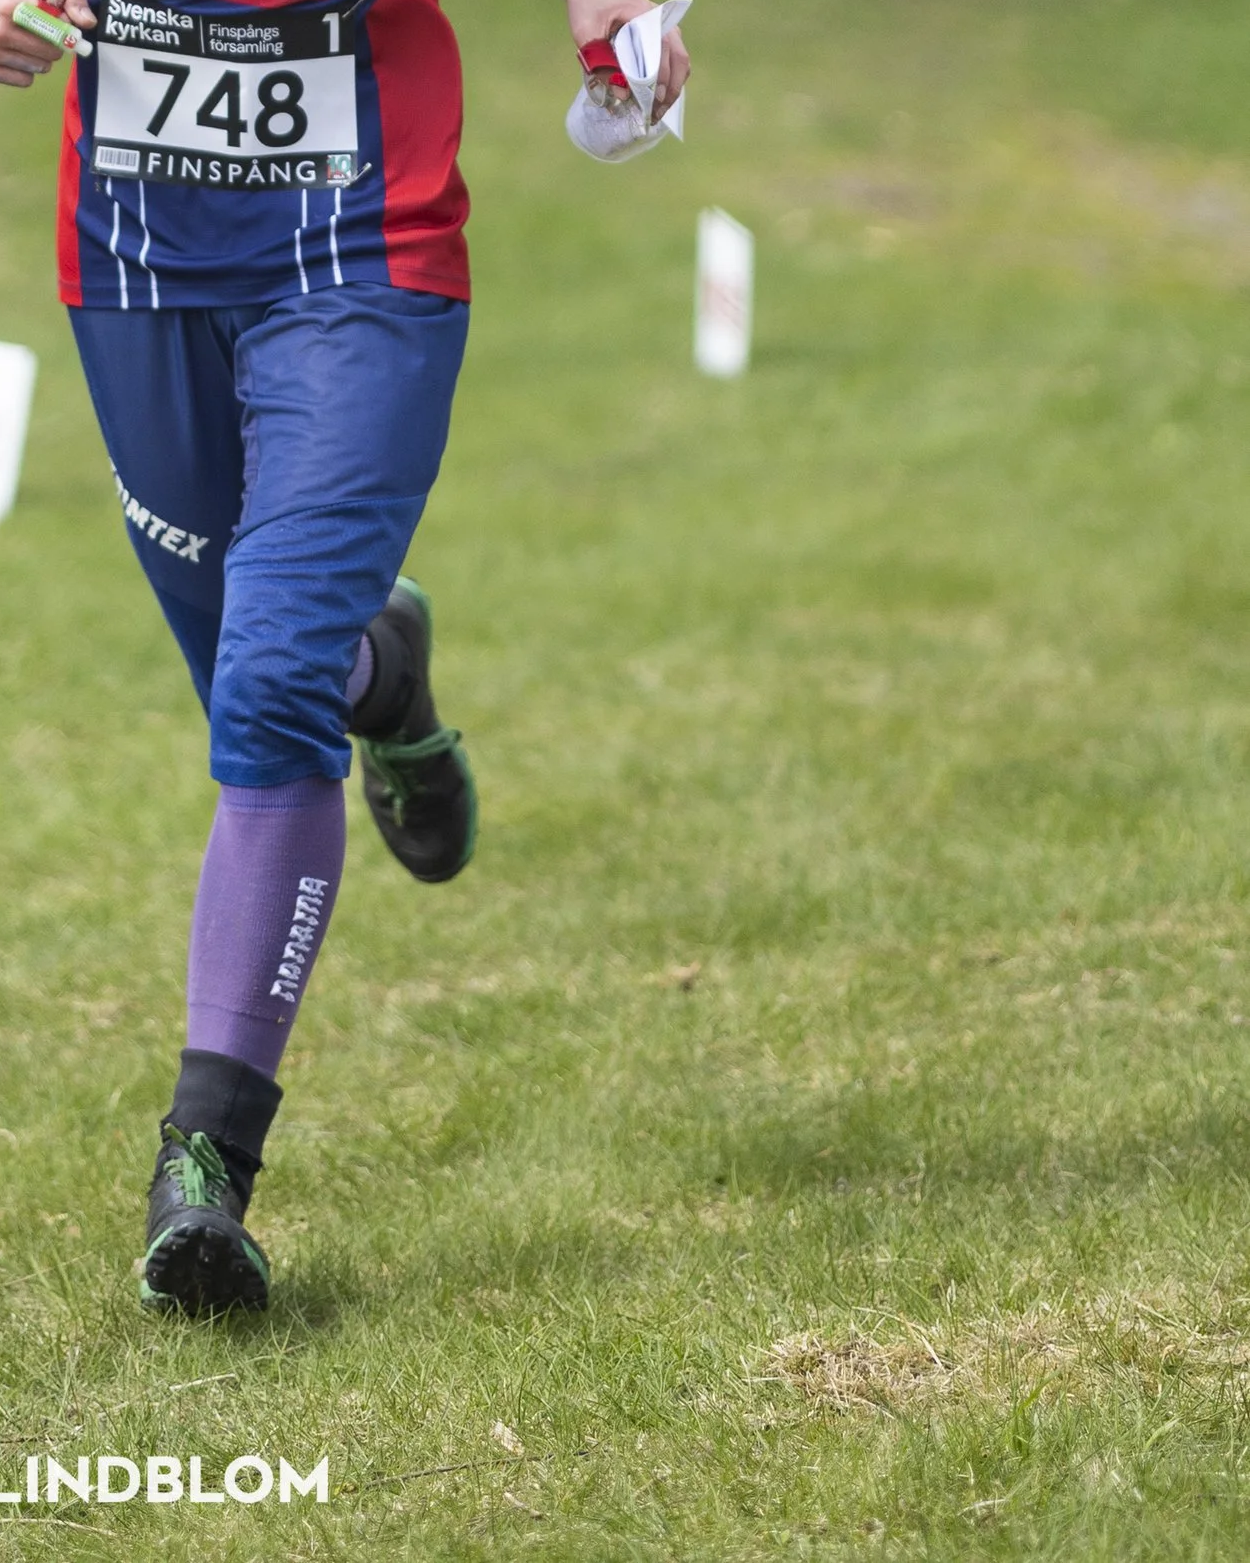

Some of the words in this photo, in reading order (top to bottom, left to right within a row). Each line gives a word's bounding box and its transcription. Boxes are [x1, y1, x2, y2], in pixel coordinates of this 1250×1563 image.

[105, 16, 181, 46] kyrkan
[209, 23, 280, 42] Finspångs
[322, 12, 340, 53] 1
[209, 38, 284, 56] församling
[142, 57, 308, 148] 748
[146, 152, 317, 184] FINSPÅNG
